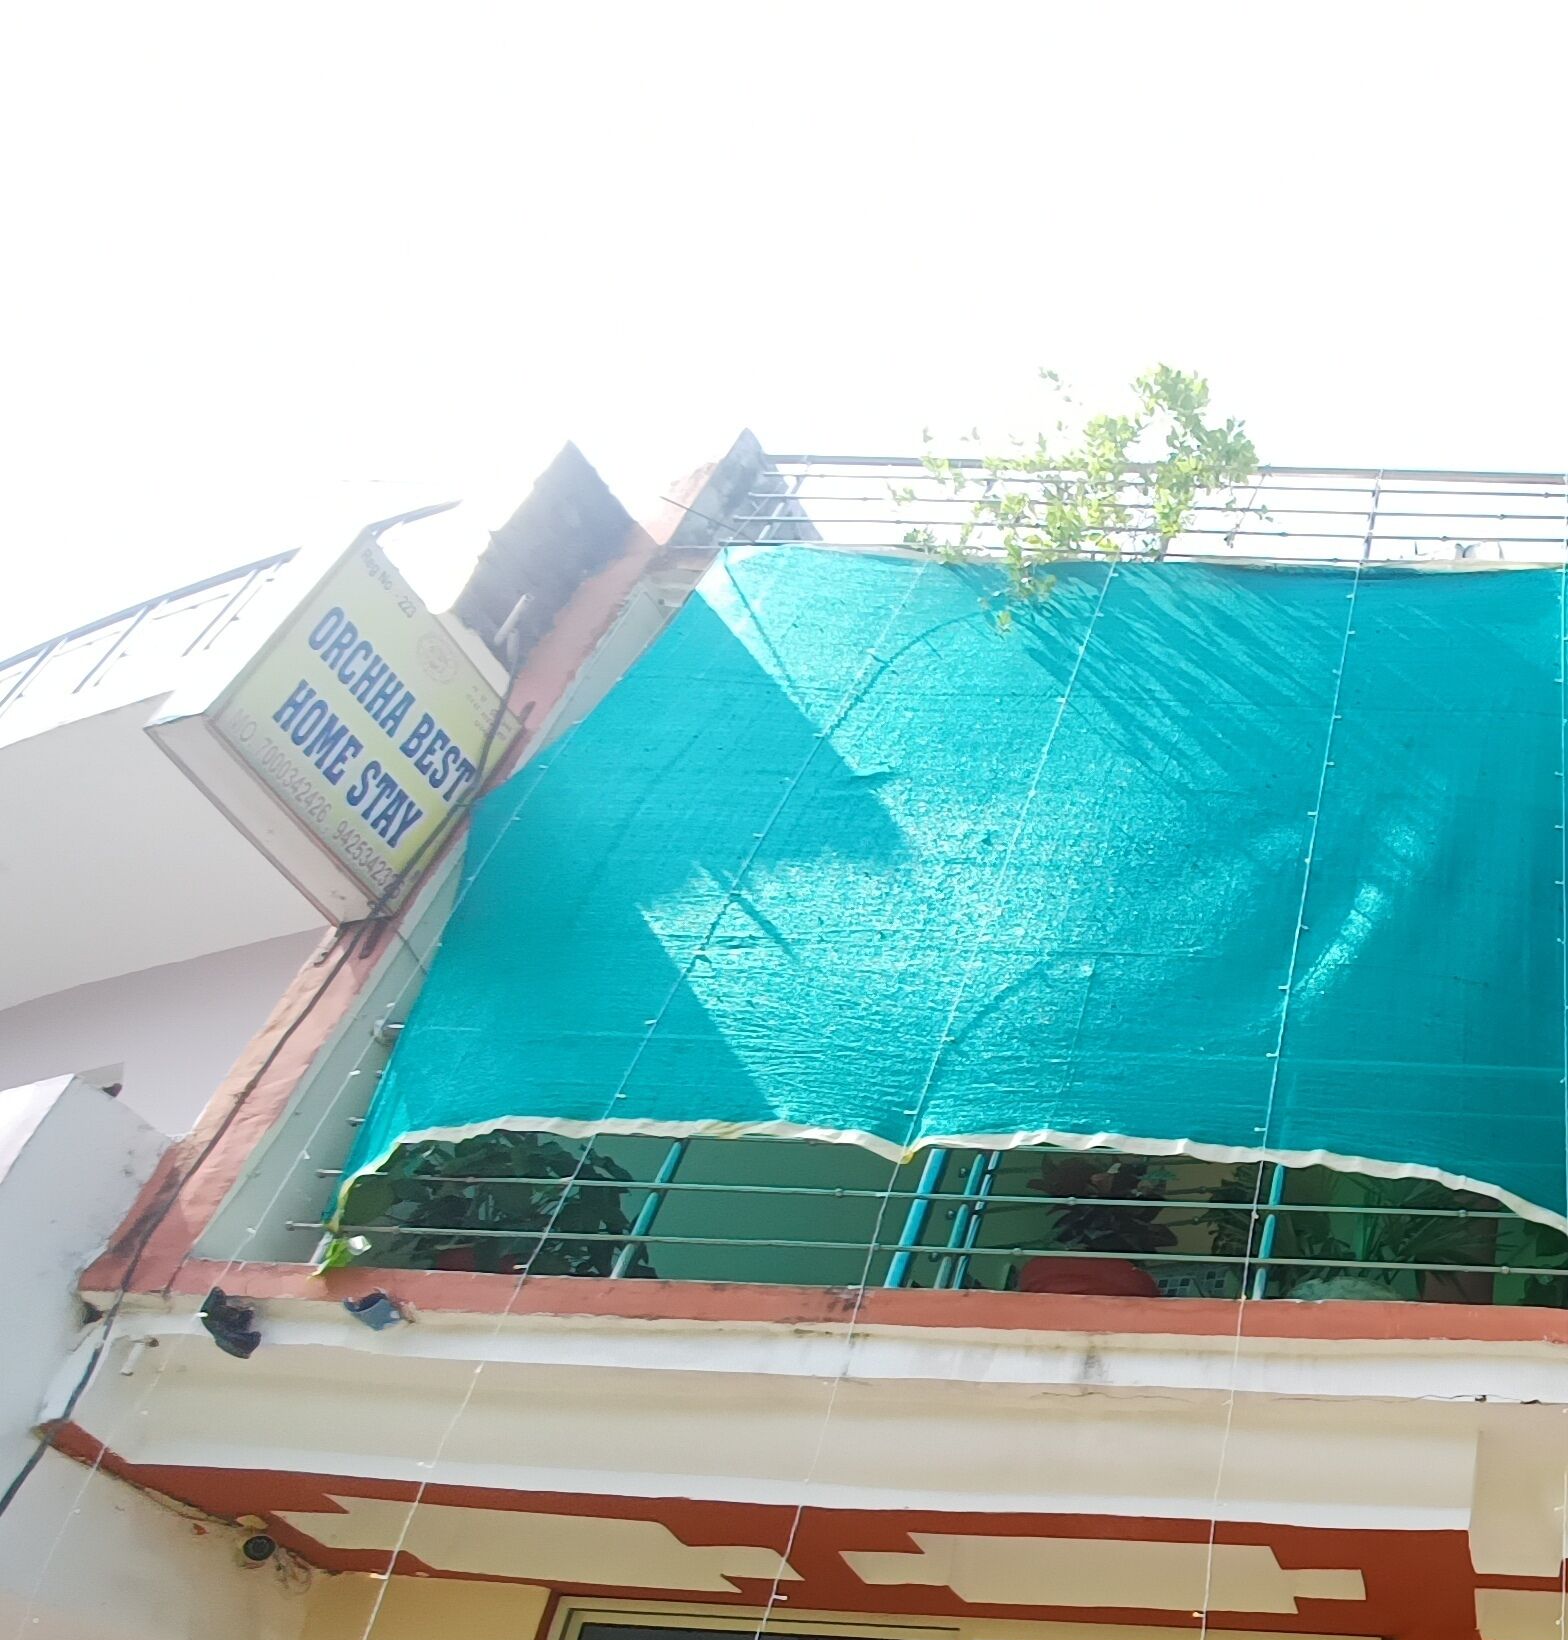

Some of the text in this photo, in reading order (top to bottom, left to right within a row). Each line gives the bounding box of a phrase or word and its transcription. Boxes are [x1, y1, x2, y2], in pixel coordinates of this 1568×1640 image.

[272, 679, 424, 849] HOME STAY
[308, 606, 477, 802] ORCHHA BEST
